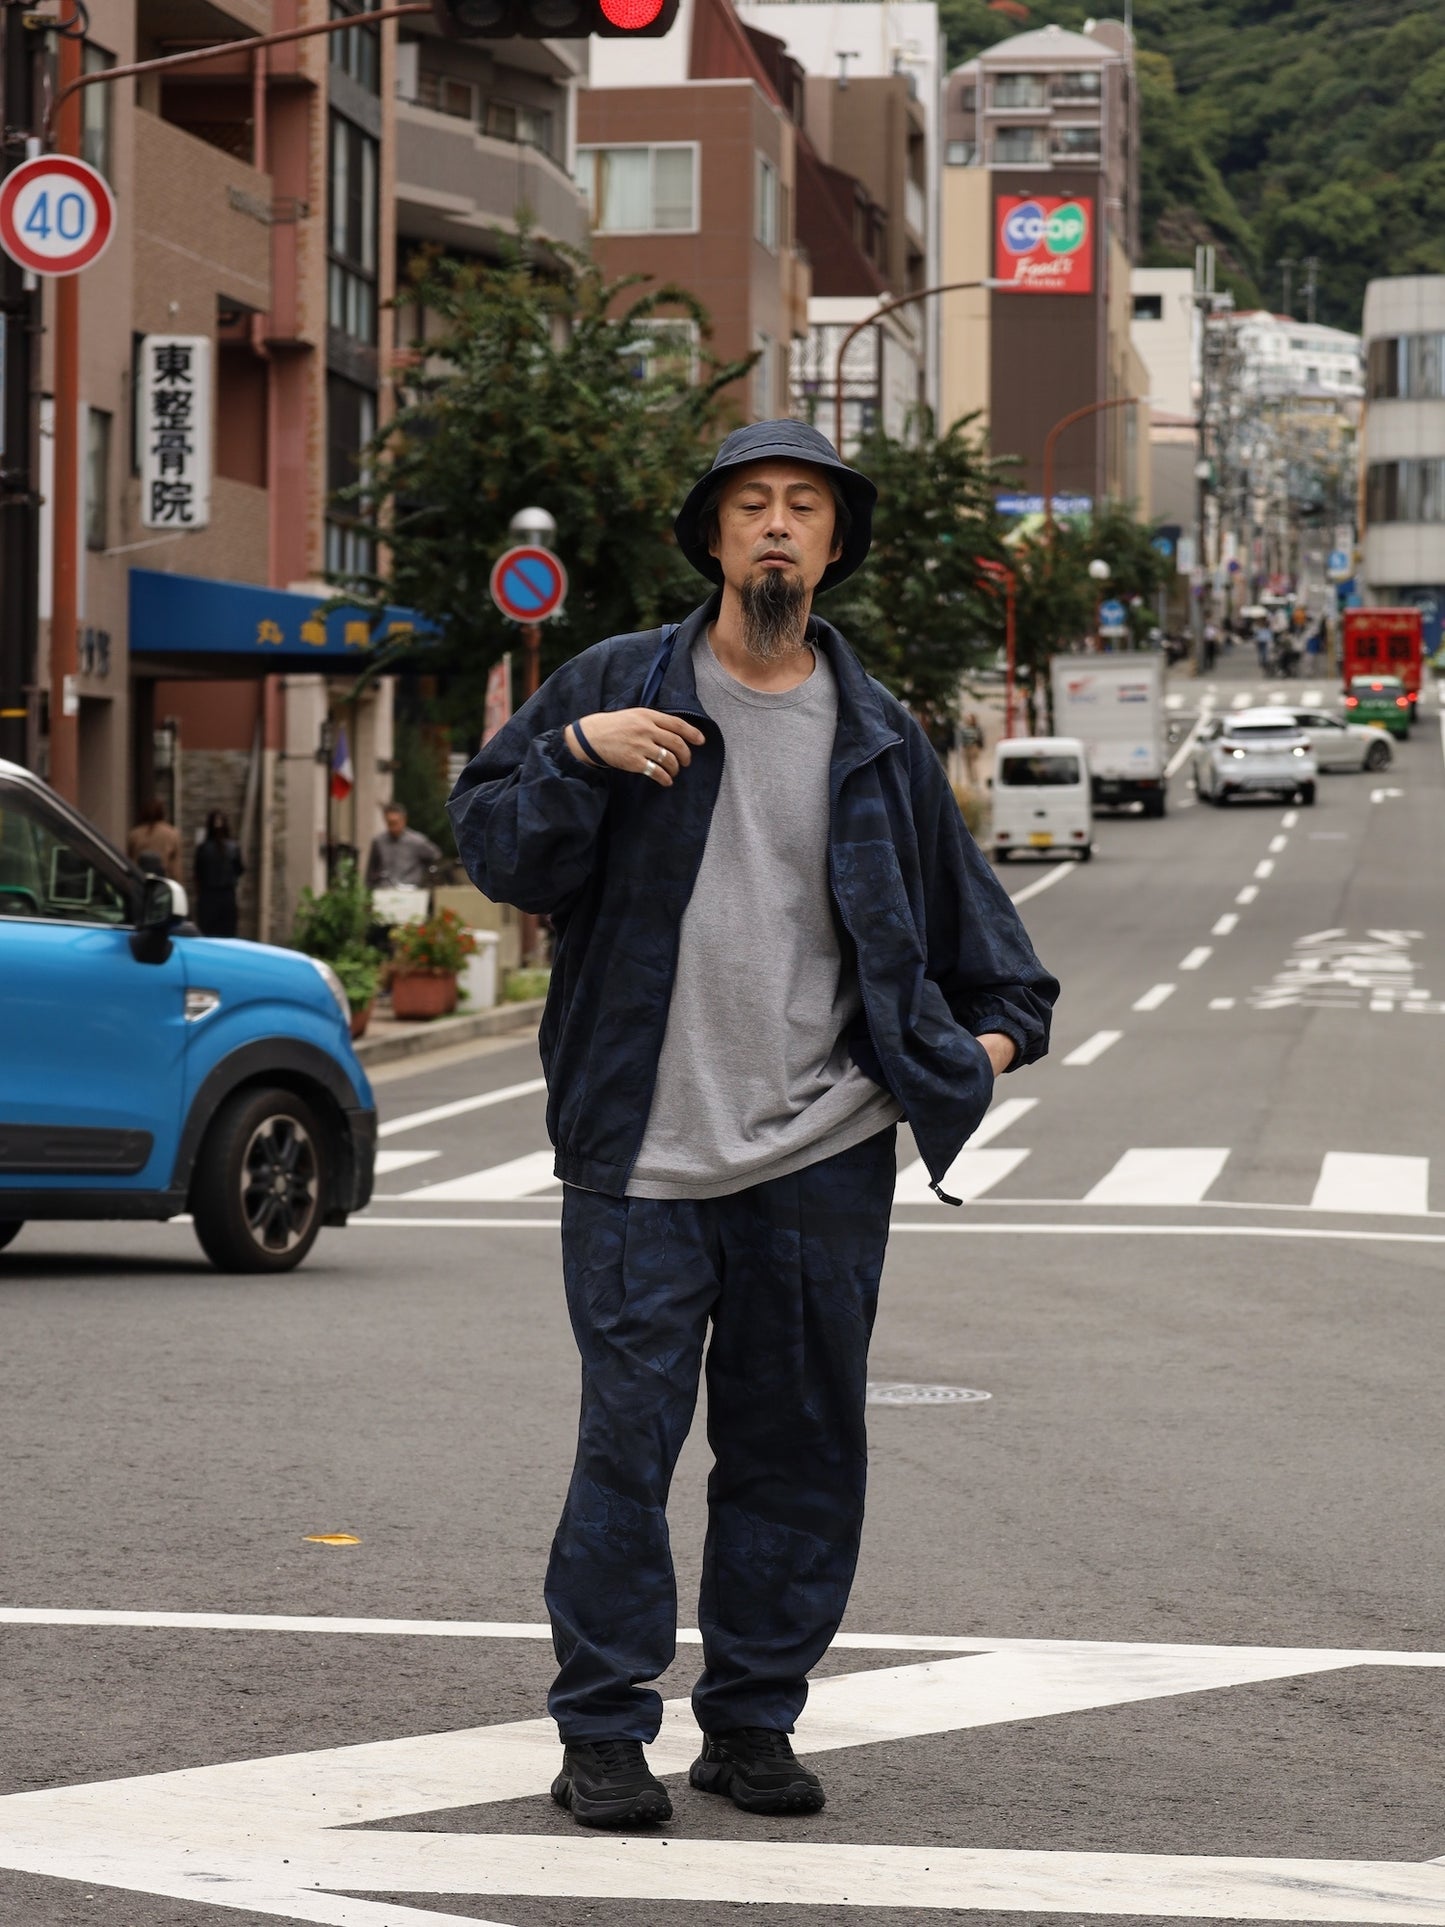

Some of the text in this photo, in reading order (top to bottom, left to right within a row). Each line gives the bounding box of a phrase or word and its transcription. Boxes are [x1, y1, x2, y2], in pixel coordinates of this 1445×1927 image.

[24, 190, 85, 240] 40
[152, 343, 194, 522] 東整骨院
